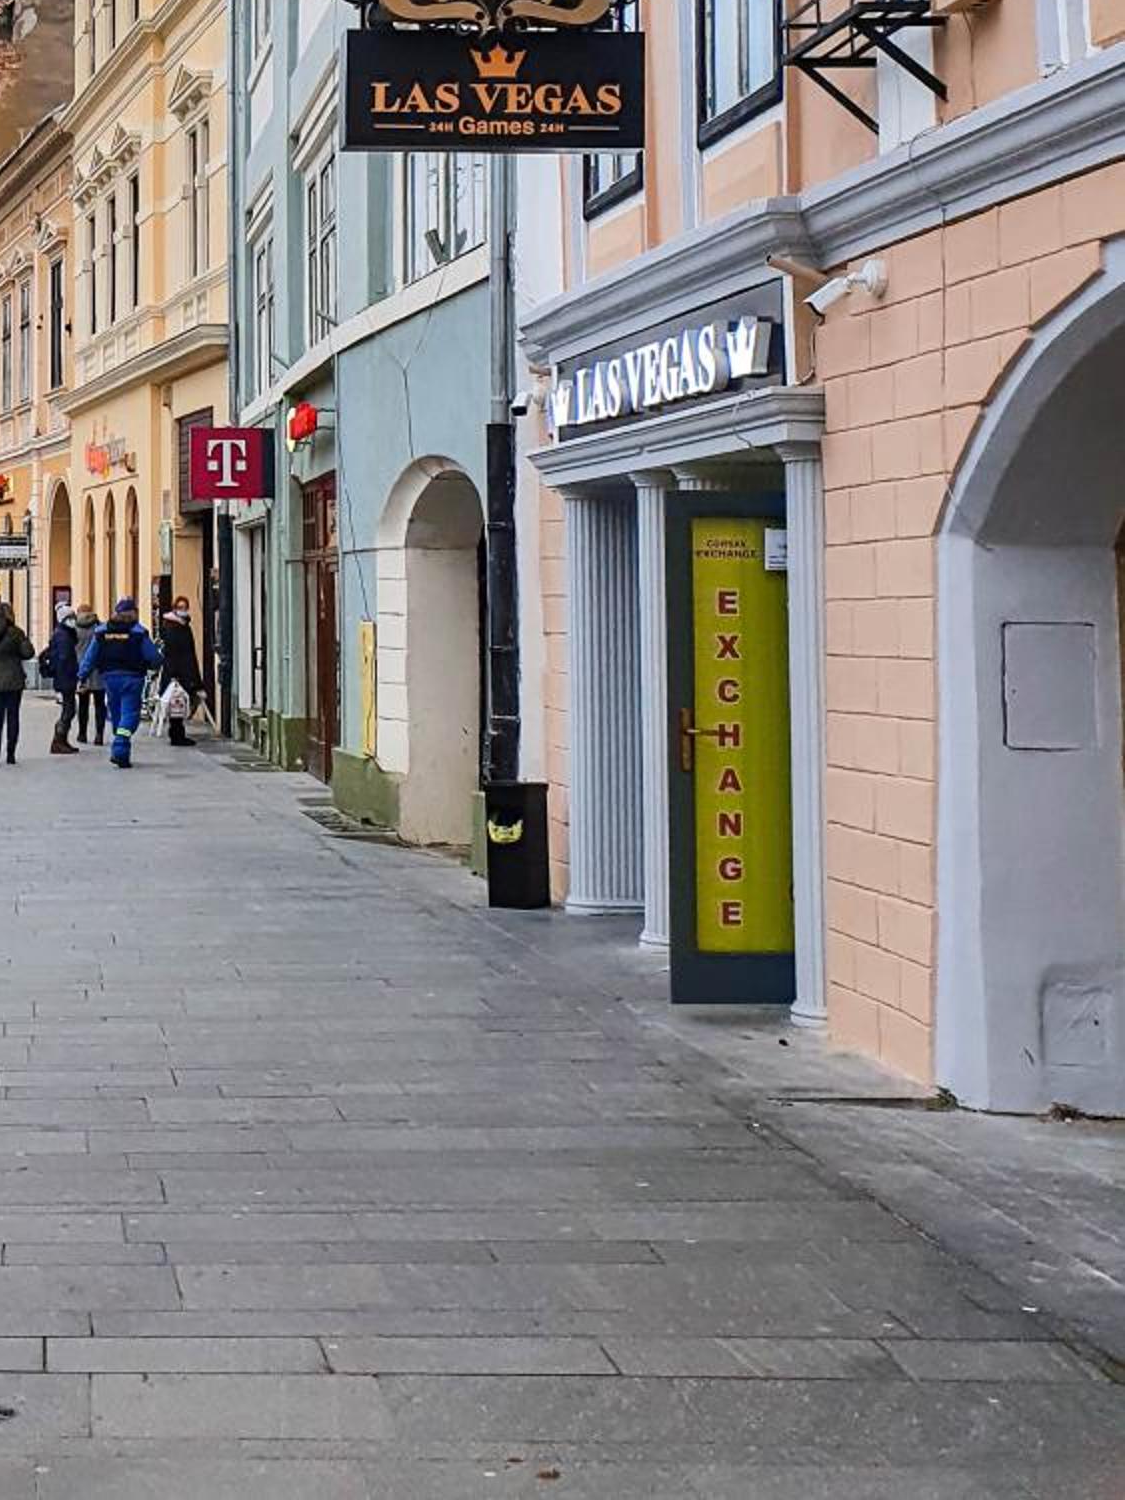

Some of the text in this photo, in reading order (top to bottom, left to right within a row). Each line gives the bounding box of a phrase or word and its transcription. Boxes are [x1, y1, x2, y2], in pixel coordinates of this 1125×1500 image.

[371, 82, 623, 115] LAS VEGAS
[458, 116, 535, 135] Games
[540, 123, 565, 134] 24H
[575, 323, 718, 425] LAS VEGAS
[207, 439, 247, 487] T
[696, 549, 757, 559] EXCHANGE
[716, 589, 743, 927] EXCHANGE
